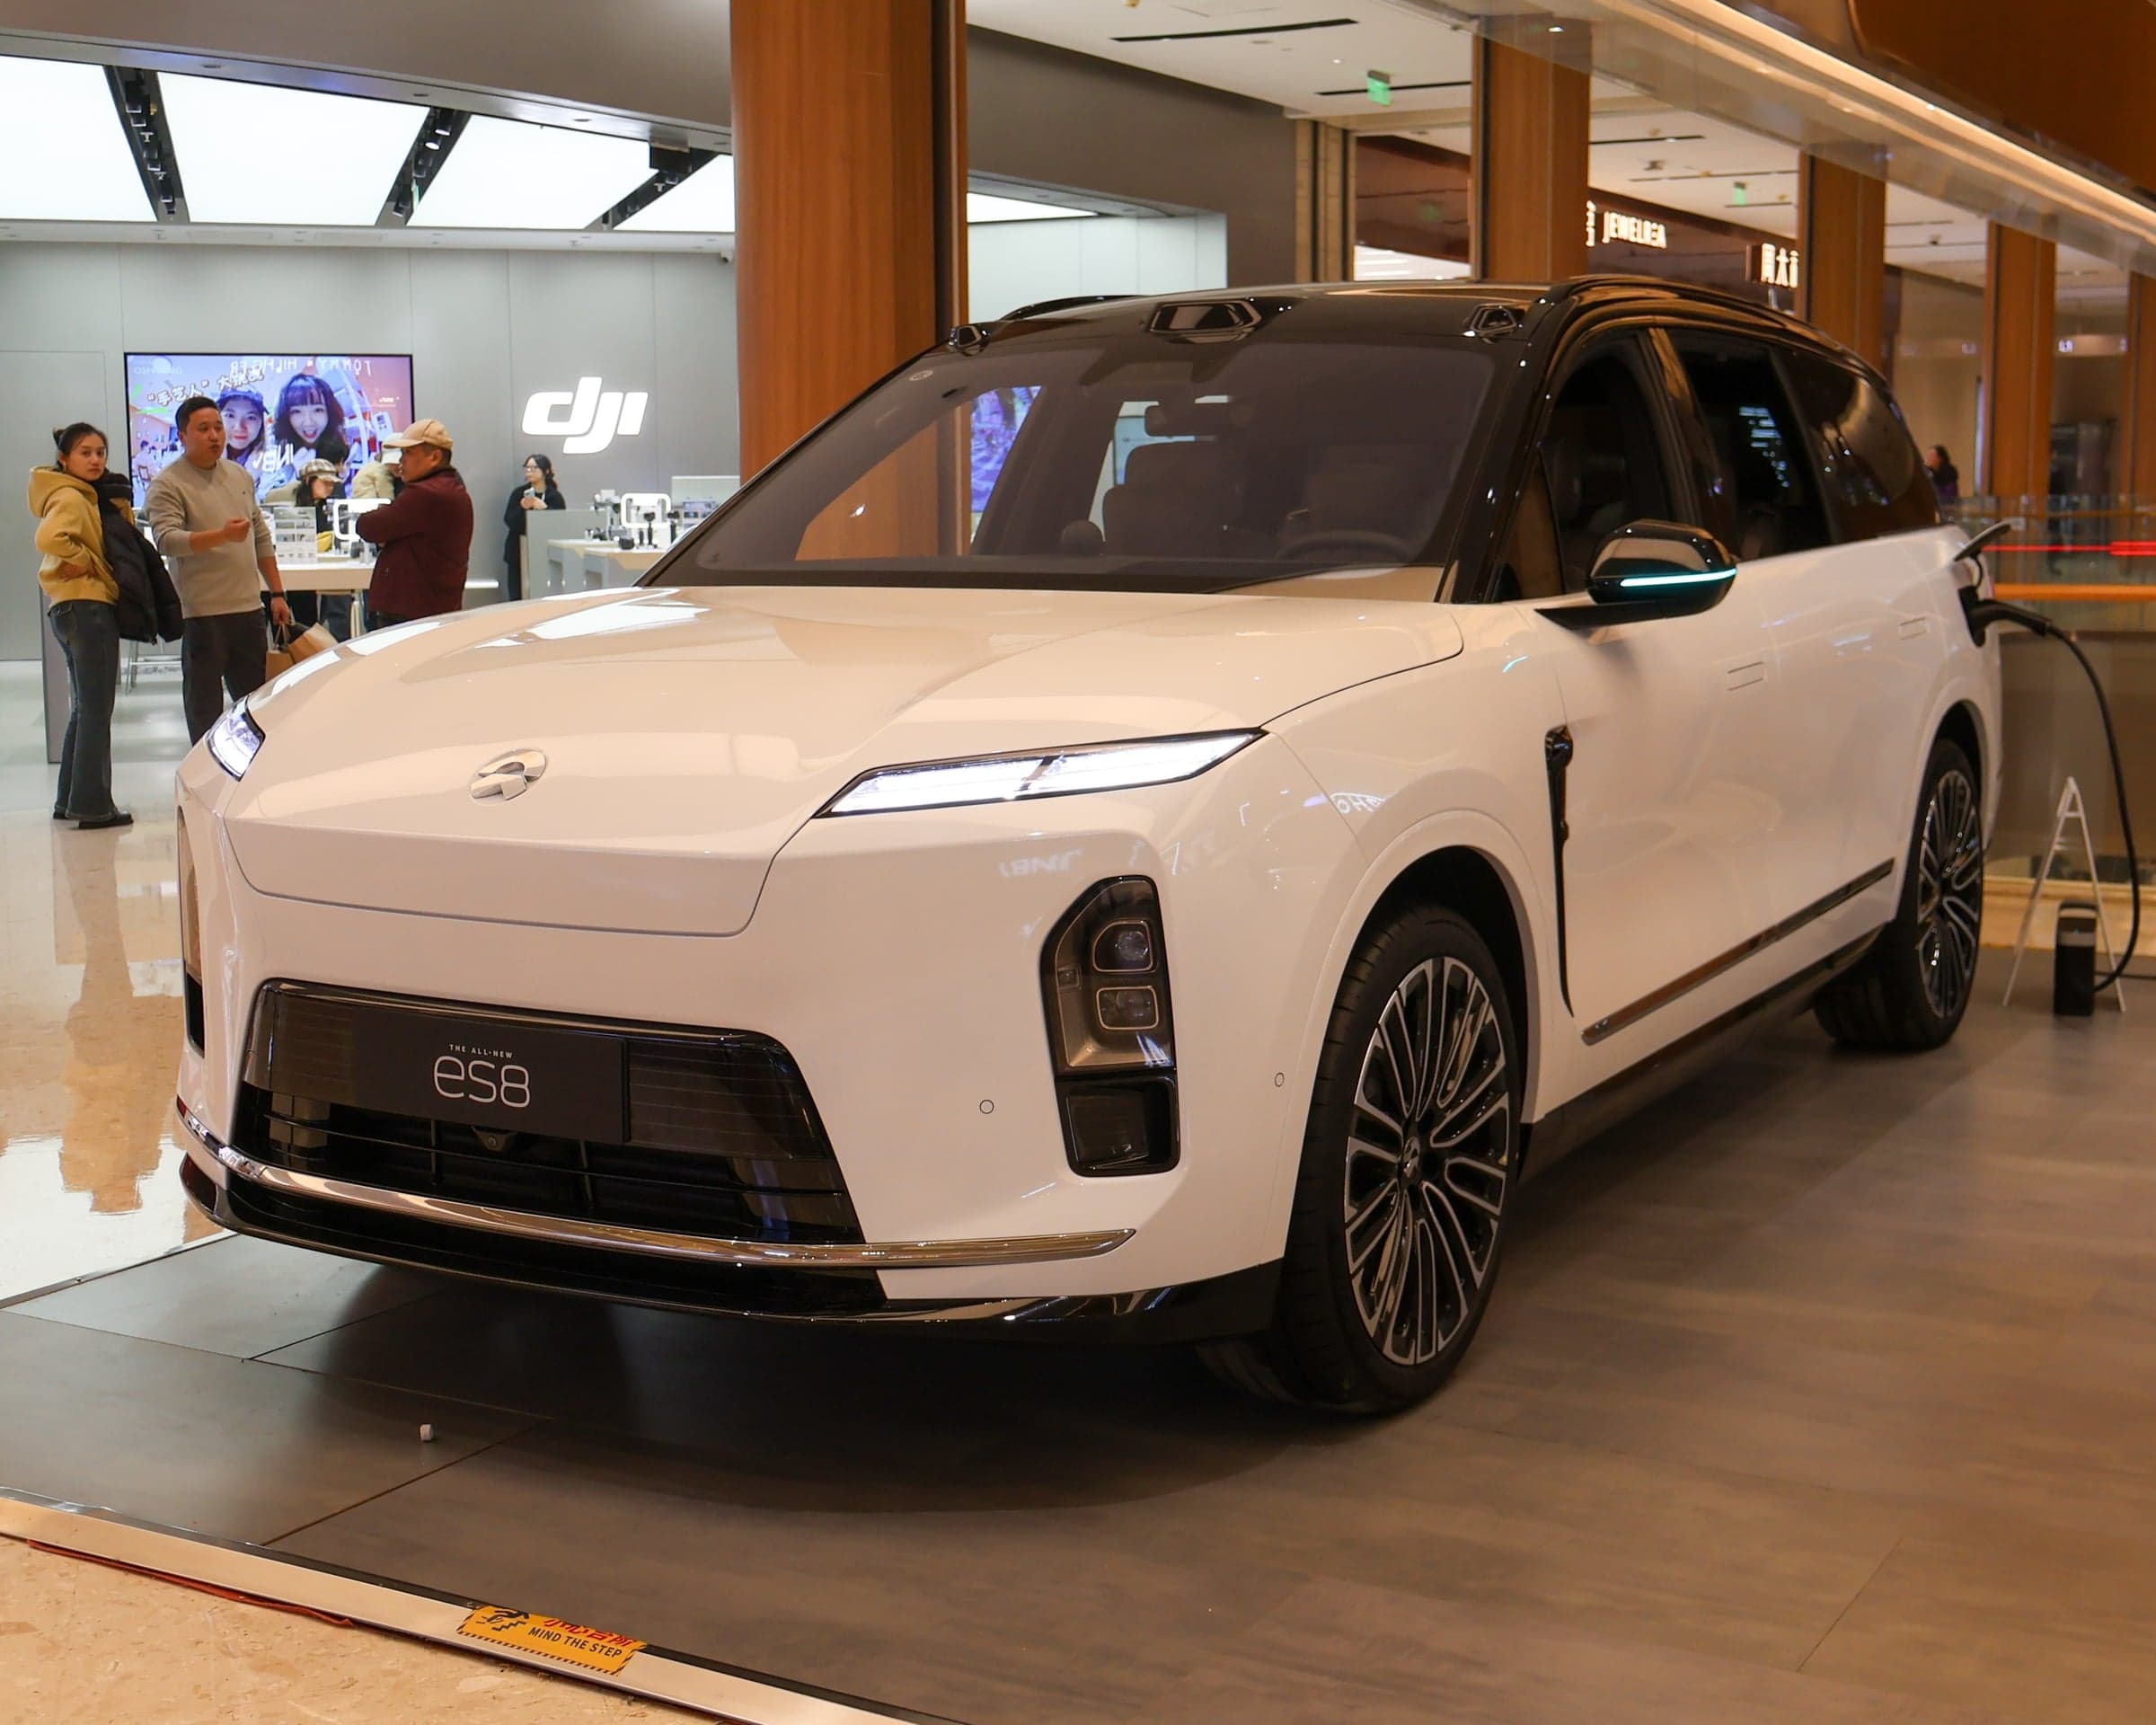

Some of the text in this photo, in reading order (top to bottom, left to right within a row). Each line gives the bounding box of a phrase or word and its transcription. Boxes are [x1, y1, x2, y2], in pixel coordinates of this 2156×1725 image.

[449, 1044, 513, 1058] THE ALL-NEW
[528, 1627, 623, 1659] MIND THE STEP
